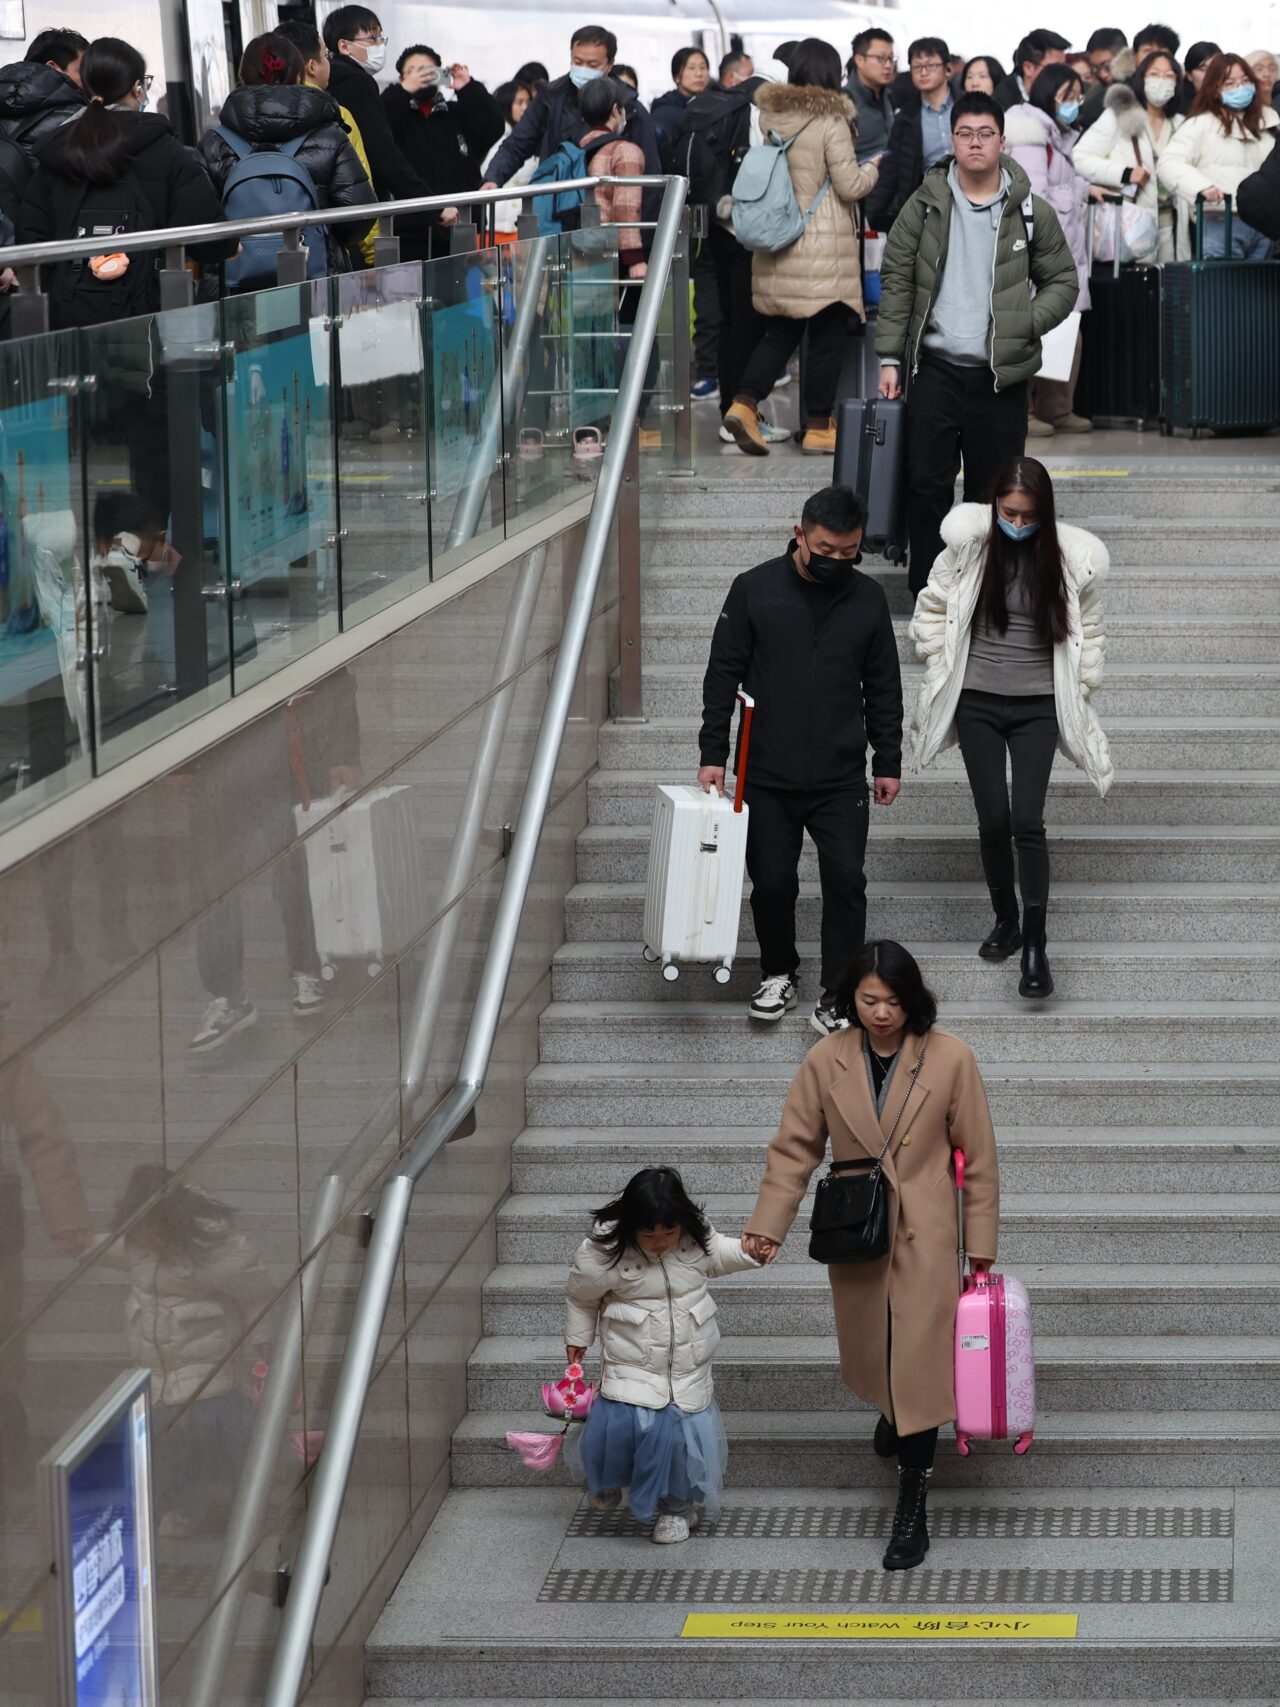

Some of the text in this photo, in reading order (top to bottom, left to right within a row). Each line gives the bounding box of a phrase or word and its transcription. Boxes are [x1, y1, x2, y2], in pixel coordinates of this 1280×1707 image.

[731, 1621, 1031, 1631] 小心台阶 Watch Your Step
